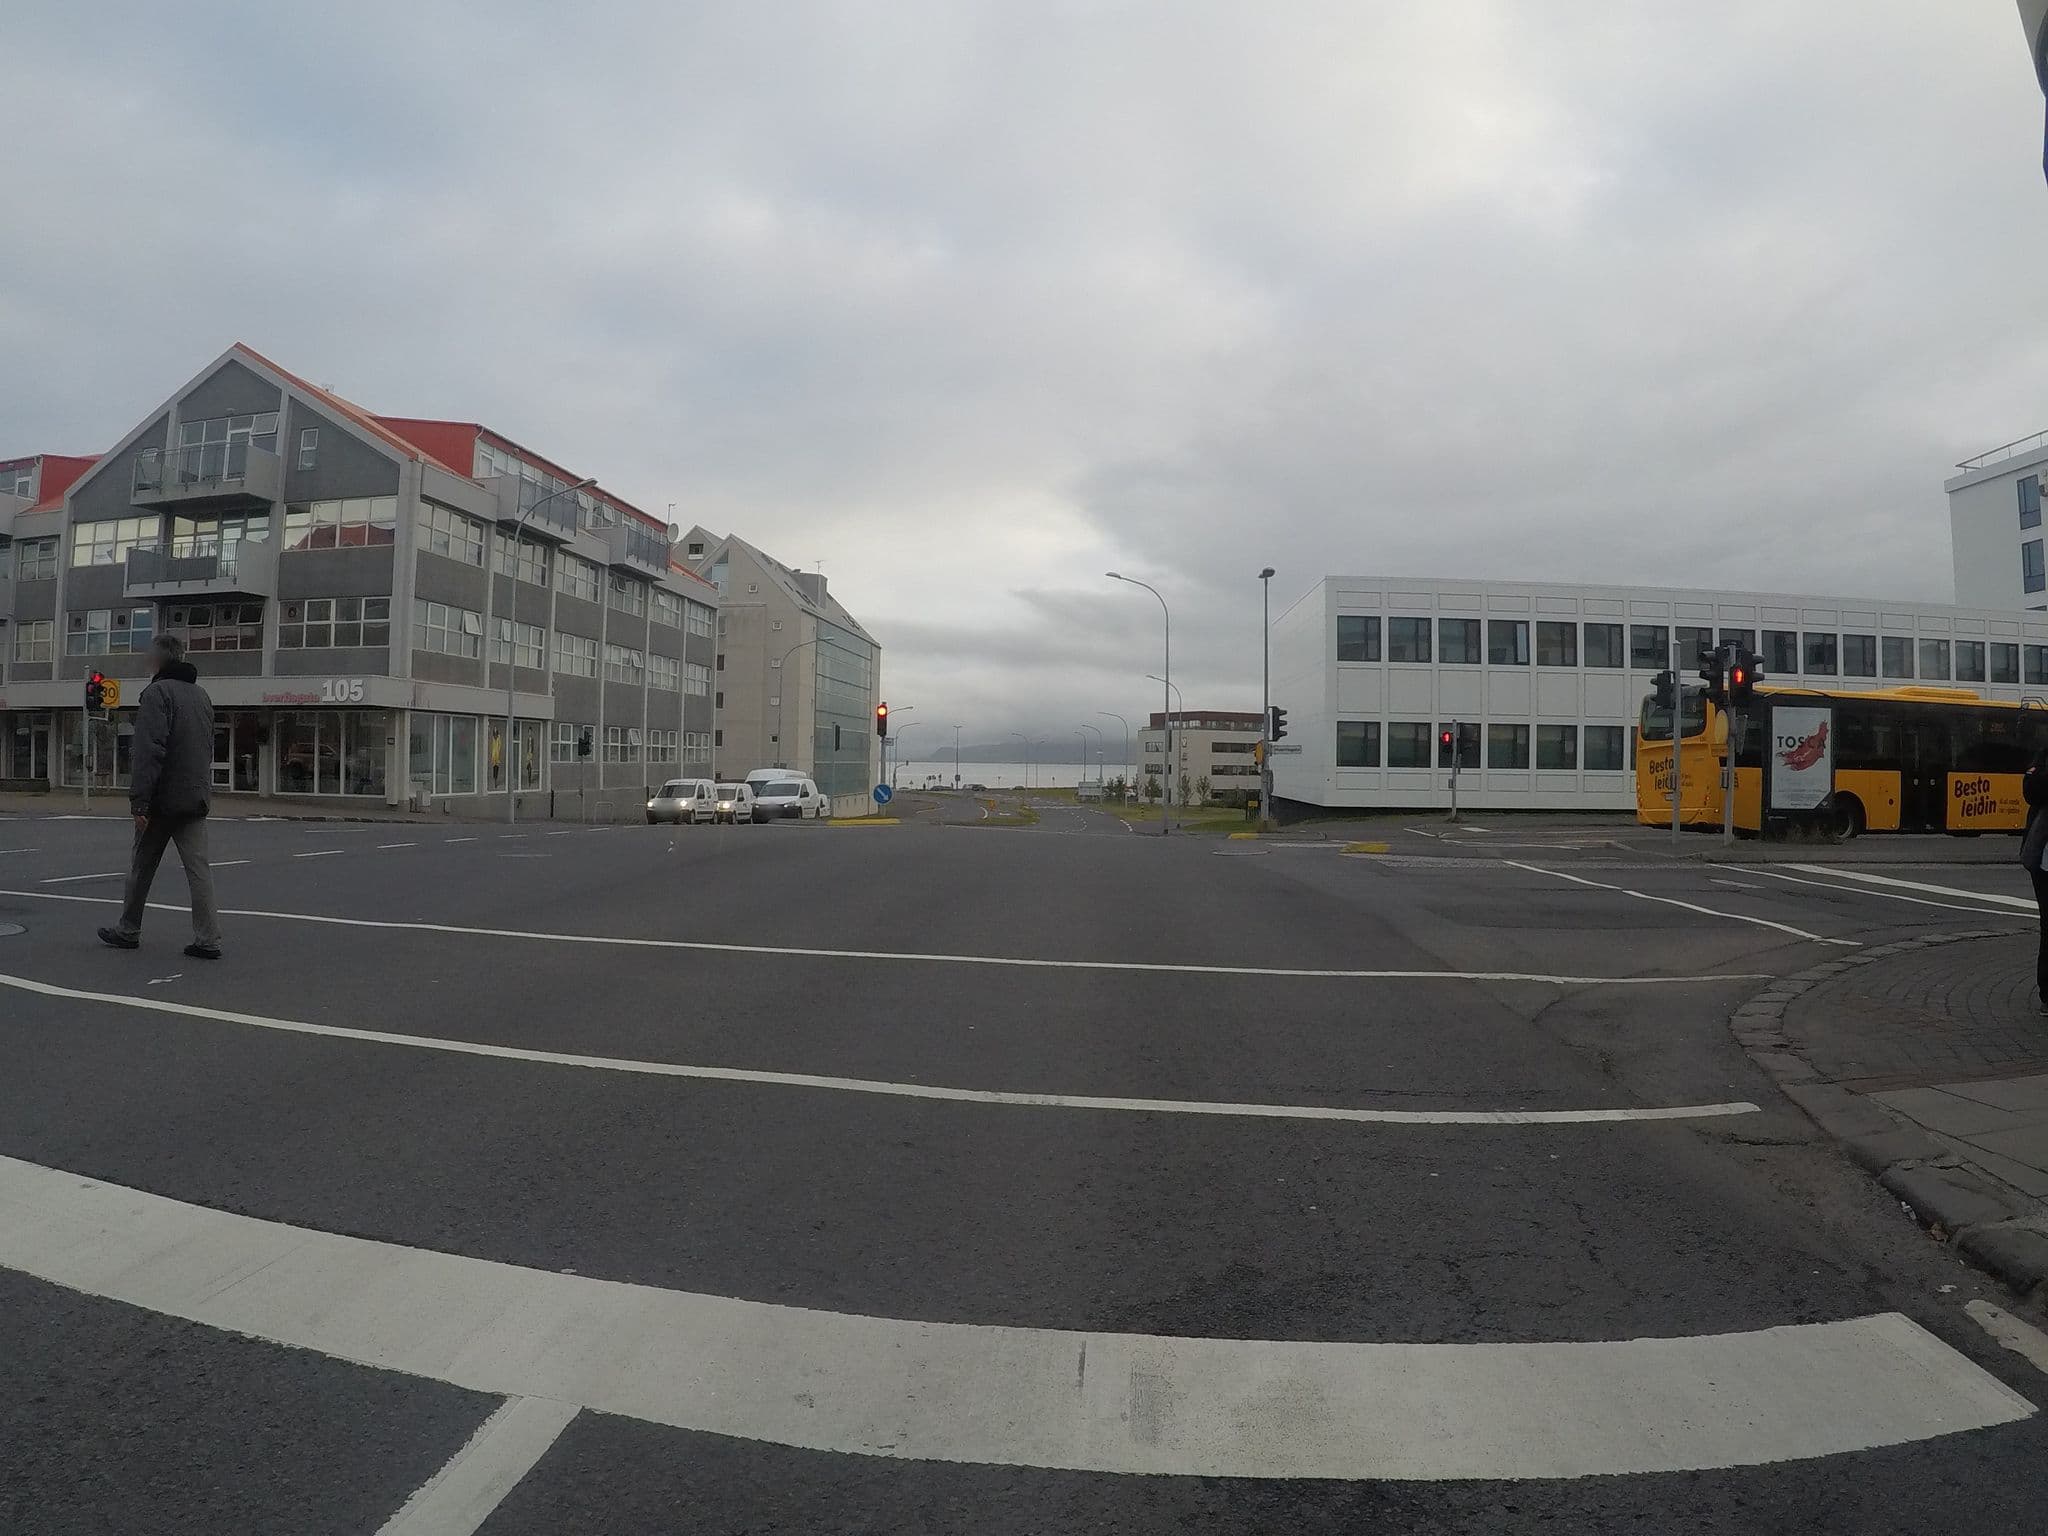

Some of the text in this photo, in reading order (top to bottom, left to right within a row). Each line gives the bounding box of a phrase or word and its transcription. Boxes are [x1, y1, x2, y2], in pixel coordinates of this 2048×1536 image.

[101, 687, 116, 698] 30
[322, 679, 364, 702] 105
[1649, 756, 1675, 775] Besta
[1954, 776, 1991, 798] Besta
[1961, 795, 1997, 817] leiðin
